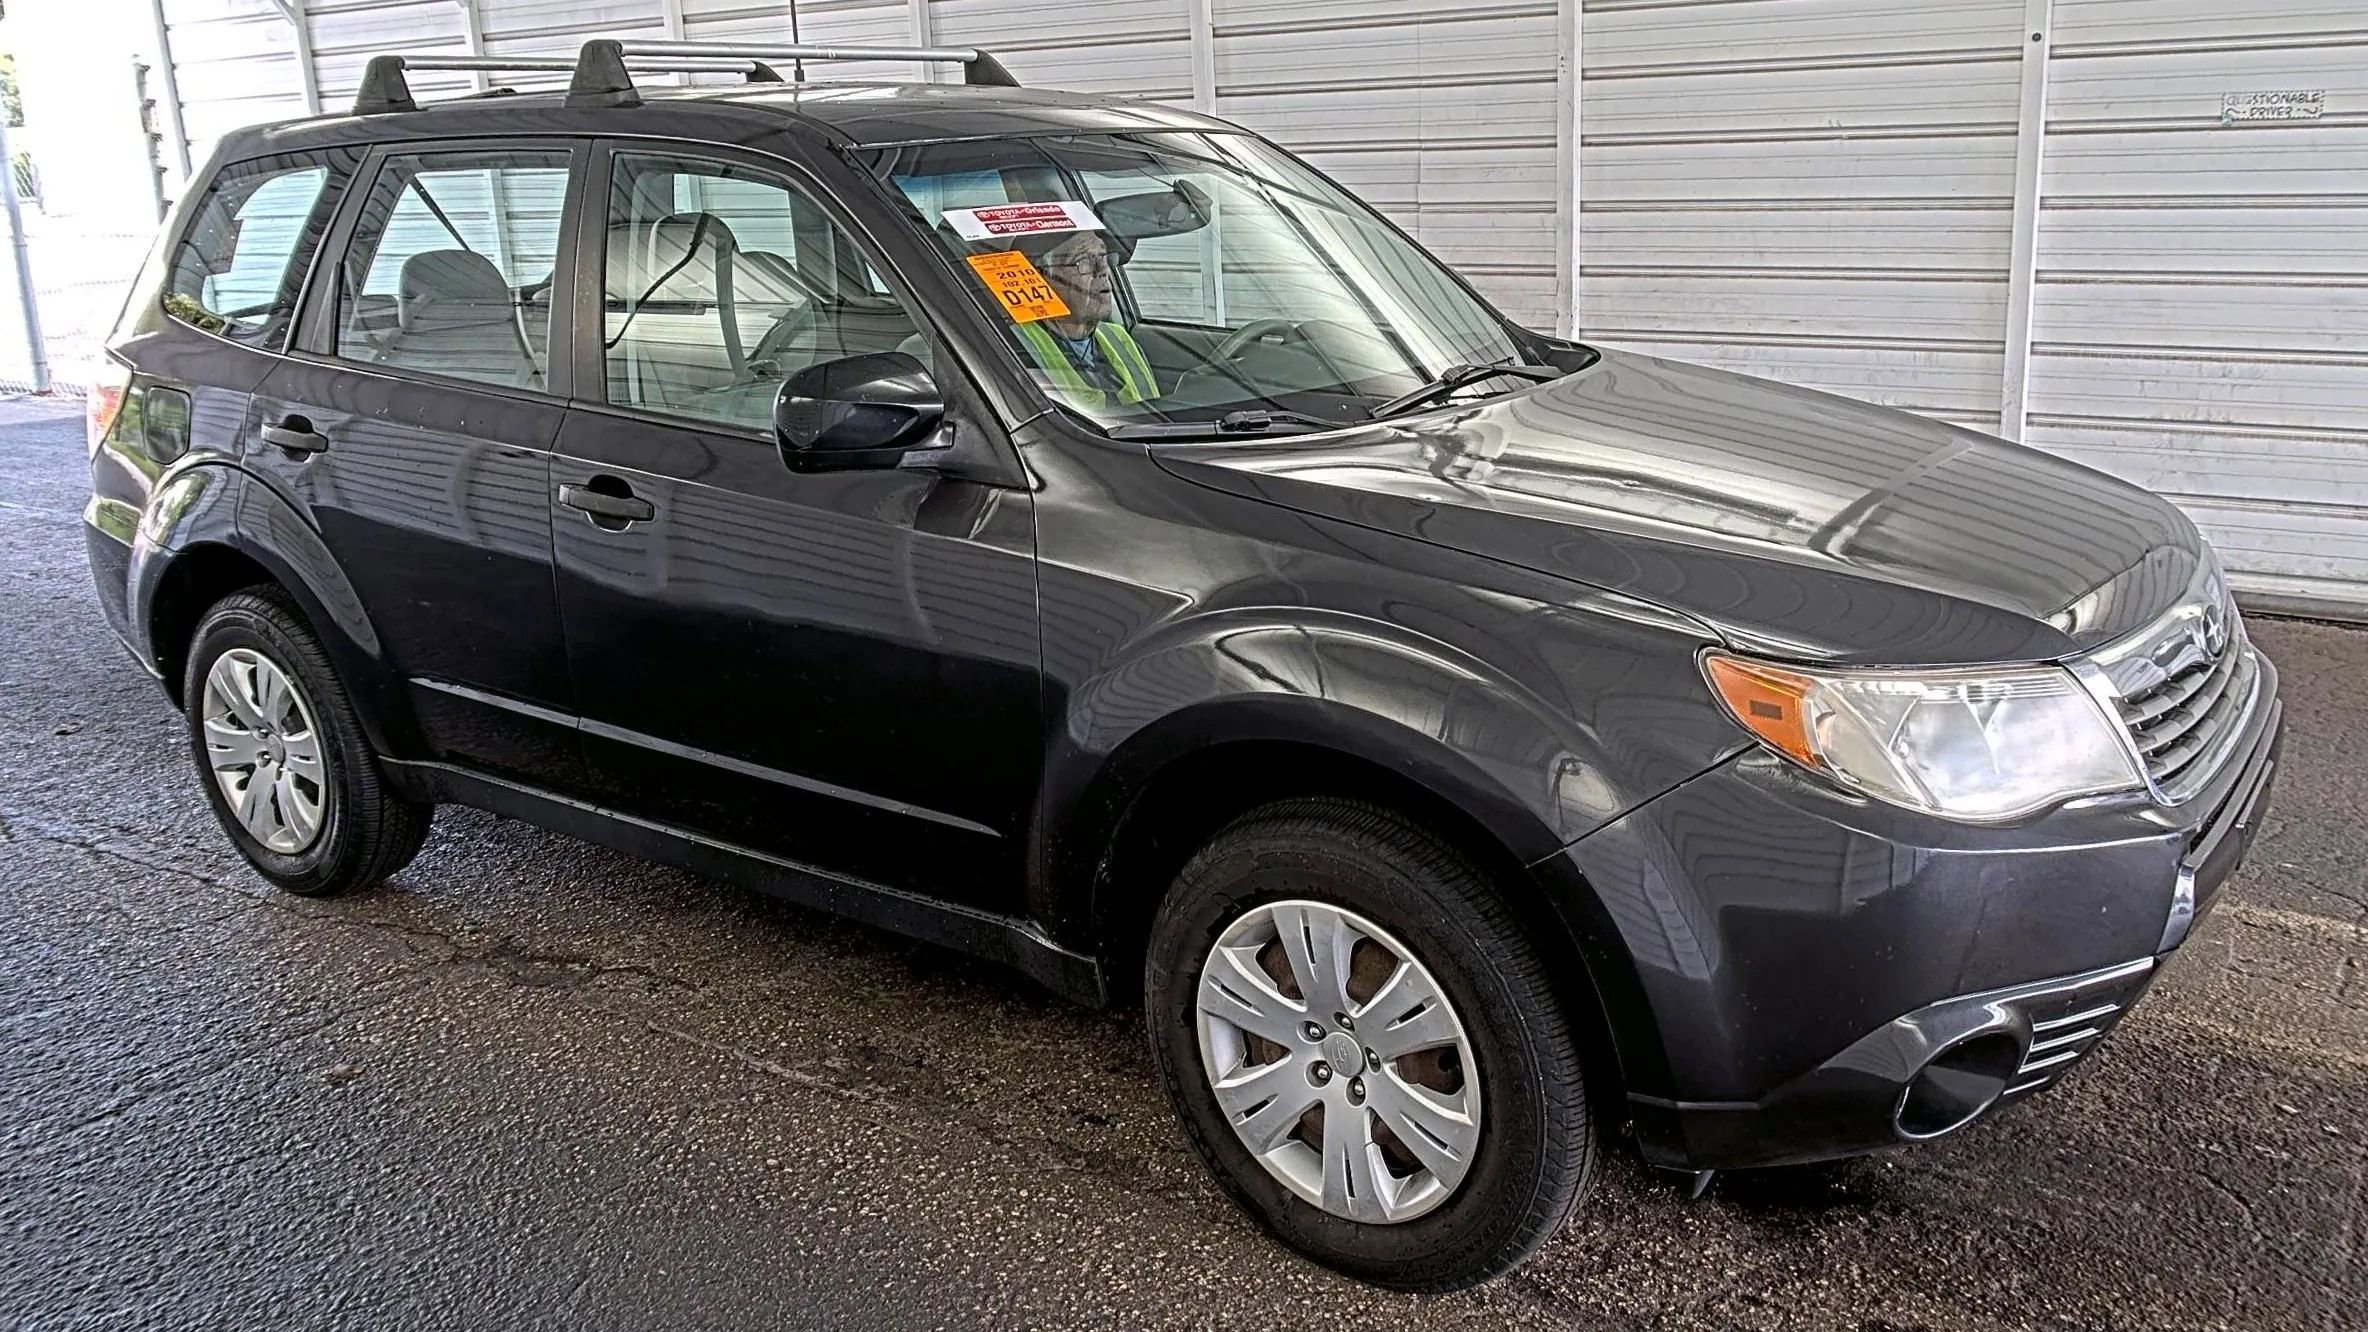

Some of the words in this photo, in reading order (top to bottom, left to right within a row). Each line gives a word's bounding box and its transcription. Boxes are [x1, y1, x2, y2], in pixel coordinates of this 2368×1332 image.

[2250, 106, 2292, 117] DRIVER
[989, 209, 1020, 217] TOYOTA
[1024, 205, 1062, 215] Orlando
[1000, 222, 1032, 230] TOYOTA
[1036, 219, 1074, 230] Clermont
[996, 268, 1035, 280] 2010
[1002, 285, 1053, 306] D147
